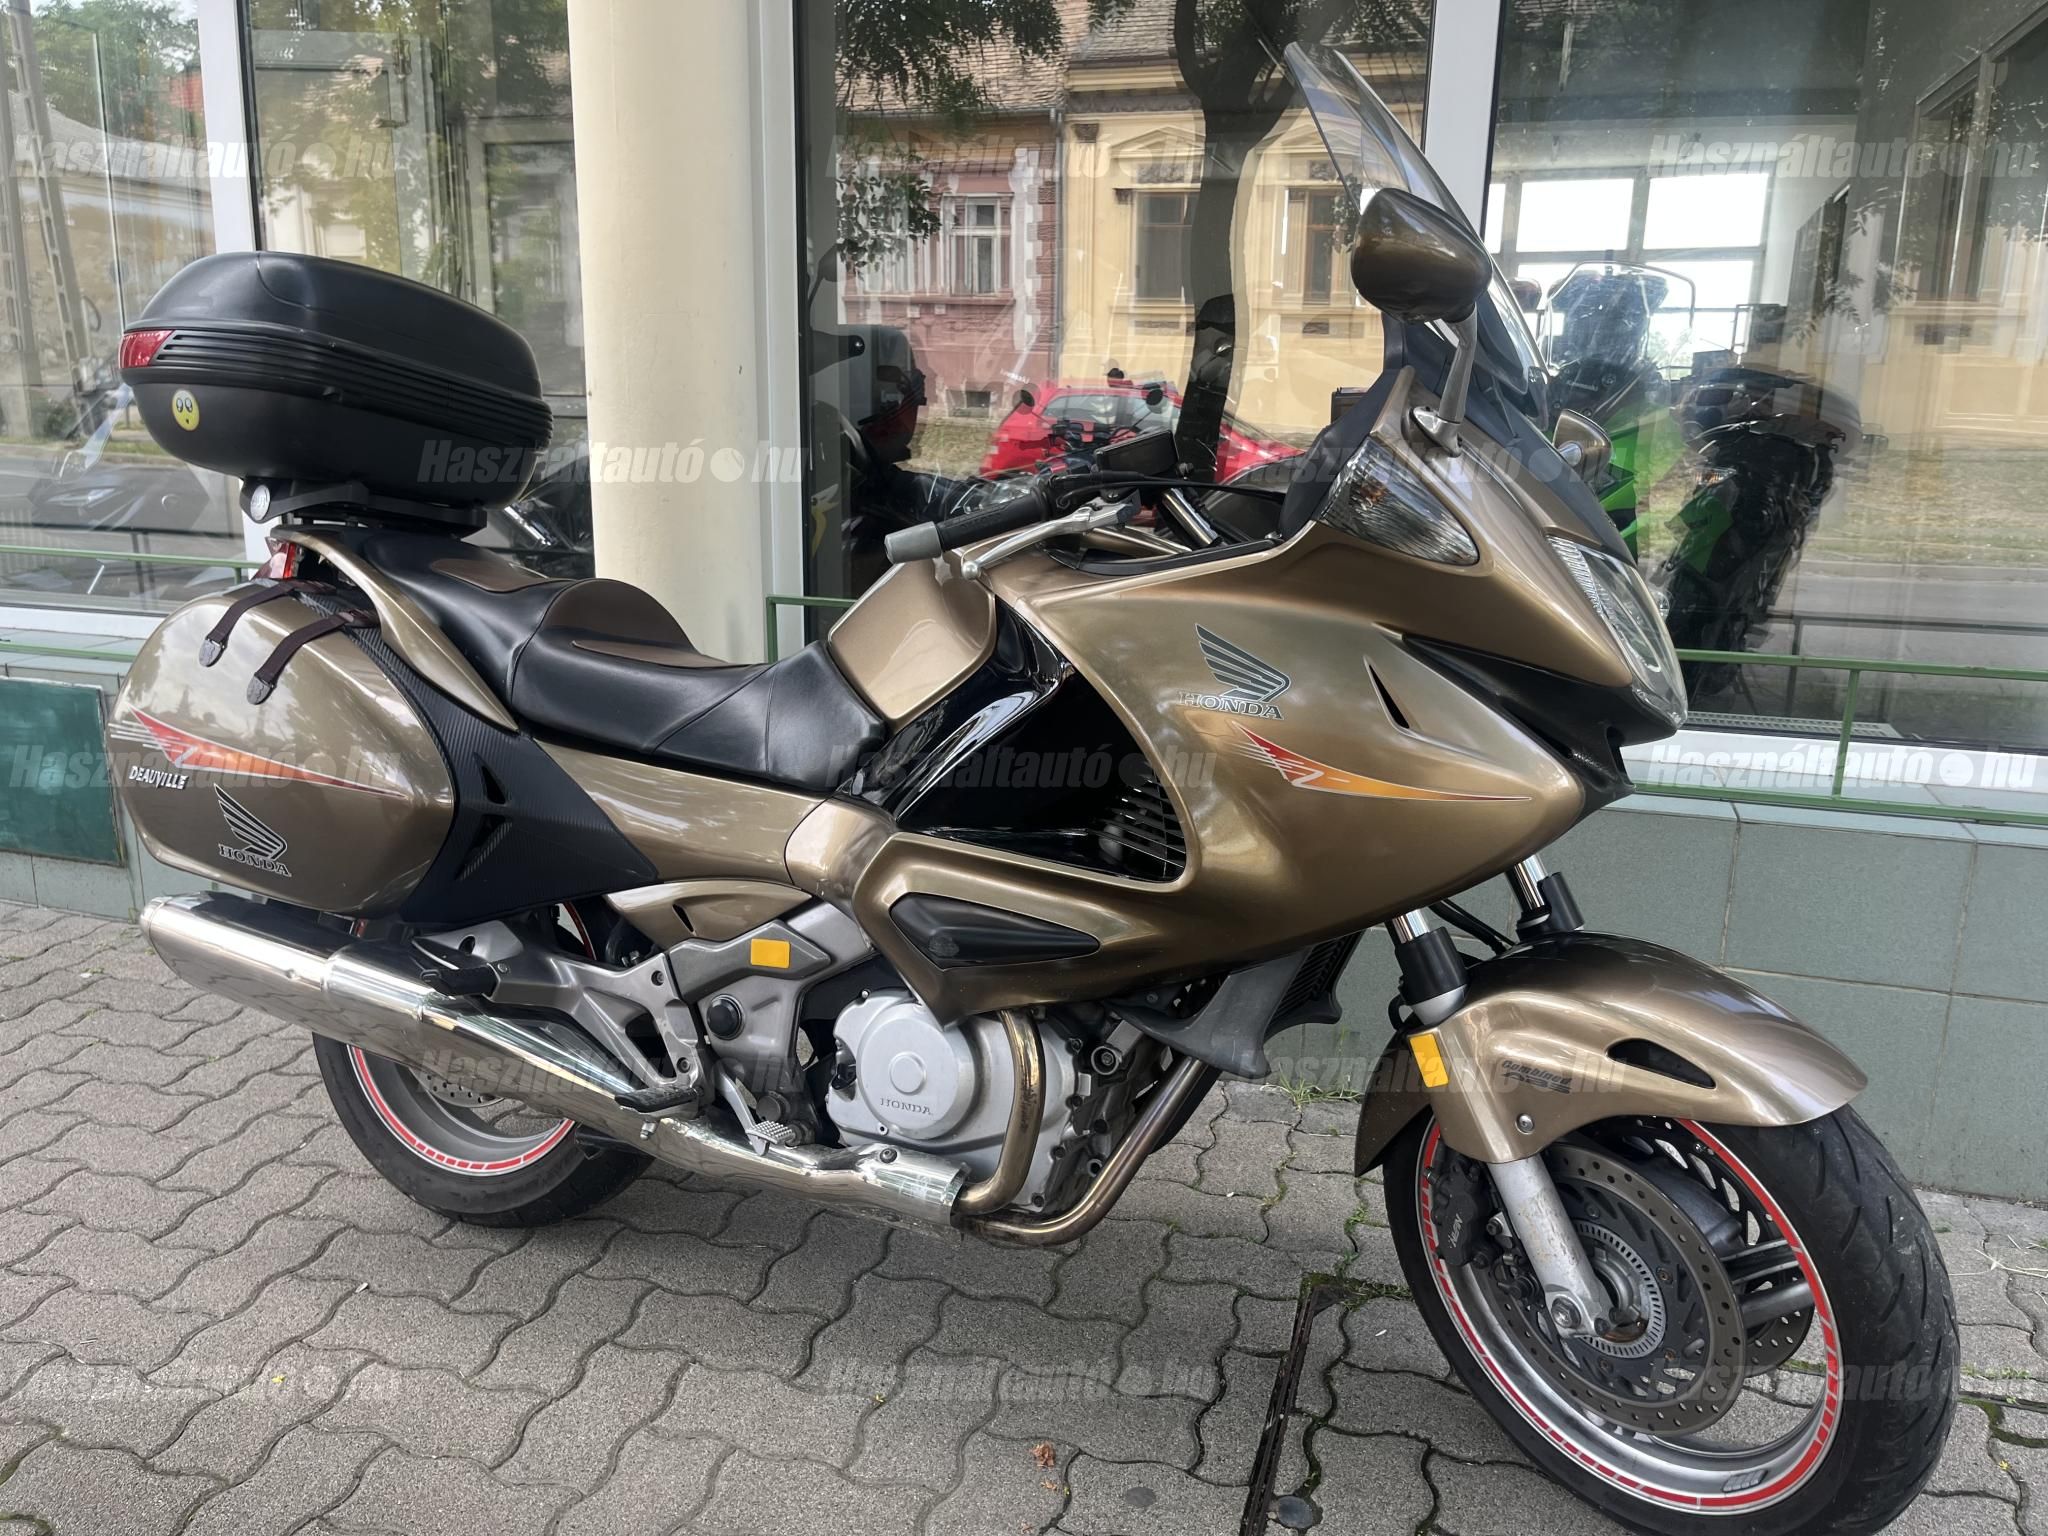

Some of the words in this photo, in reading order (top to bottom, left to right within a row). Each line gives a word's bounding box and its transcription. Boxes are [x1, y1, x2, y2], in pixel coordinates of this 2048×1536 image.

[1179, 691, 1284, 720] HONDA
[129, 766, 190, 789] DEAUVILLE
[218, 843, 292, 877] HONDA
[1502, 1060, 1572, 1085] Combined
[880, 1098, 933, 1115] HONDA
